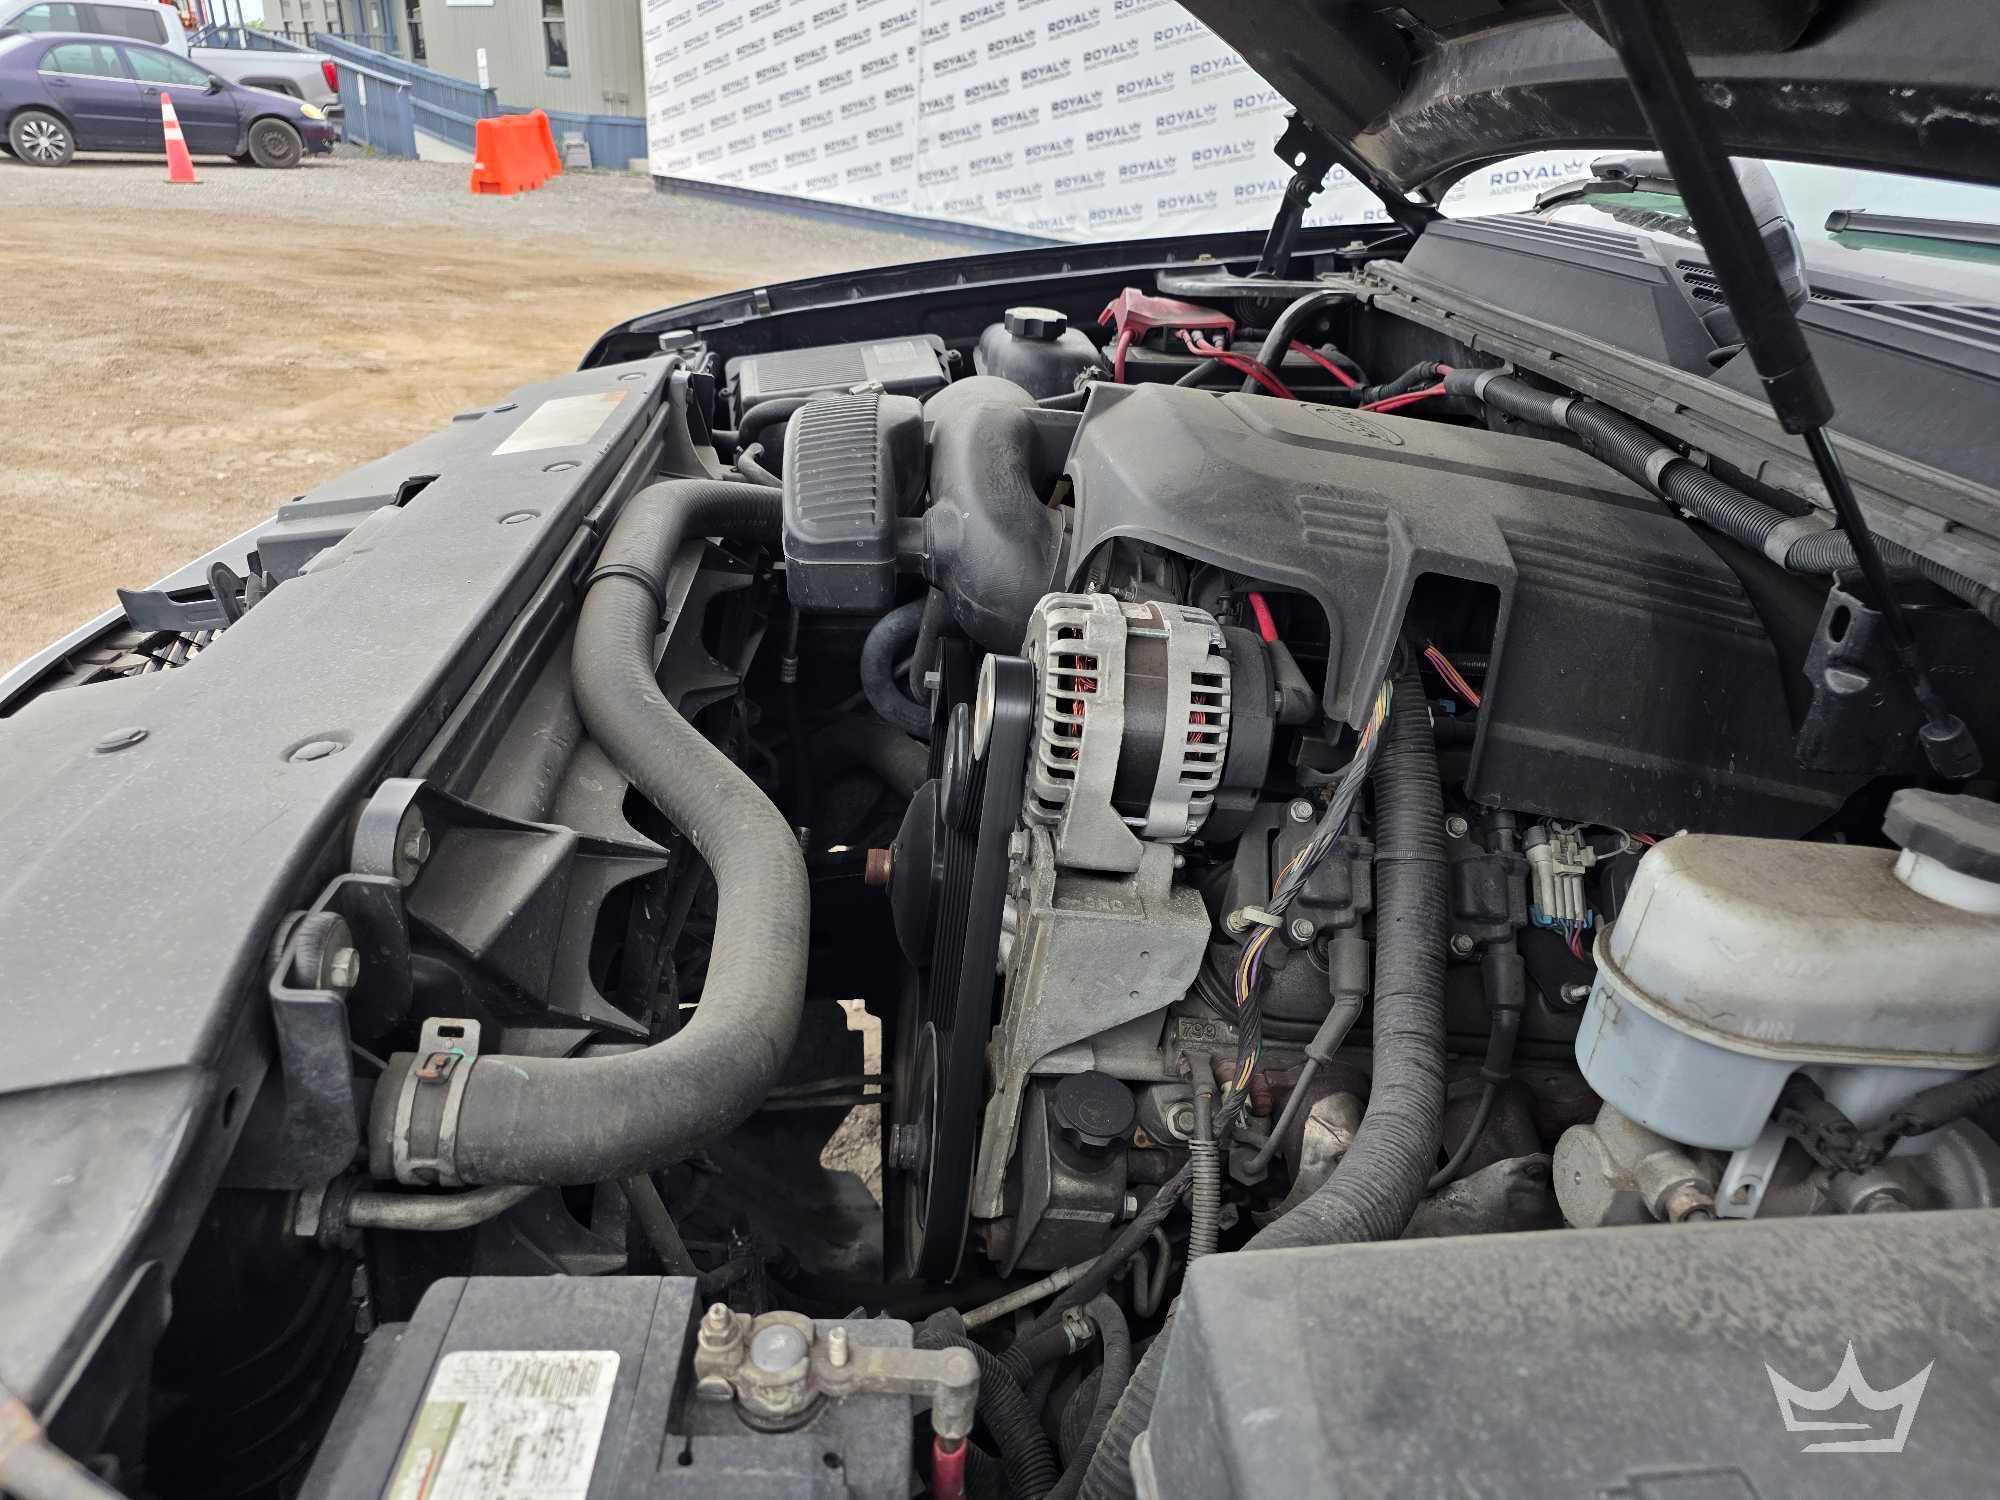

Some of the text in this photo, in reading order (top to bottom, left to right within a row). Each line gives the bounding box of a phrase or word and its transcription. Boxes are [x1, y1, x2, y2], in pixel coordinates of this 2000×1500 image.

[960, 5, 995, 23] ROYAL
[1048, 12, 1089, 32] ROYAL
[1154, 20, 1202, 41] ROYAL
[988, 34, 1025, 51] ROYAL
[1083, 42, 1127, 62] ROYAL
[934, 53, 968, 70] ROYAL
[1190, 54, 1241, 75] ROYAL
[1021, 63, 1059, 80] ROYAL
[965, 81, 999, 97] ROYAL
[1117, 76, 1162, 95] ROYAL
[1051, 93, 1091, 111] ROYAL
[1233, 91, 1279, 109] ROYA
[992, 111, 1029, 127] ROYAL
[1156, 109, 1204, 127] ROYAL
[939, 126, 972, 141] ROYAL
[1086, 126, 1128, 142] ROYAL
[1025, 142, 1063, 157] ROYAL
[1192, 143, 1241, 161] ROYAL
[970, 154, 1002, 169] ROYAL
[1119, 159, 1163, 176] ROYAL
[1055, 176, 1093, 189] ROYAL
[1490, 164, 1562, 185] ROYAL
[996, 185, 1032, 200] ROYAL
[1234, 179, 1286, 197] ROYAL
[1157, 193, 1204, 209] ROYAL
[1089, 206, 1131, 220] ROYAL
[1743, 1021, 1793, 1040] MIN
